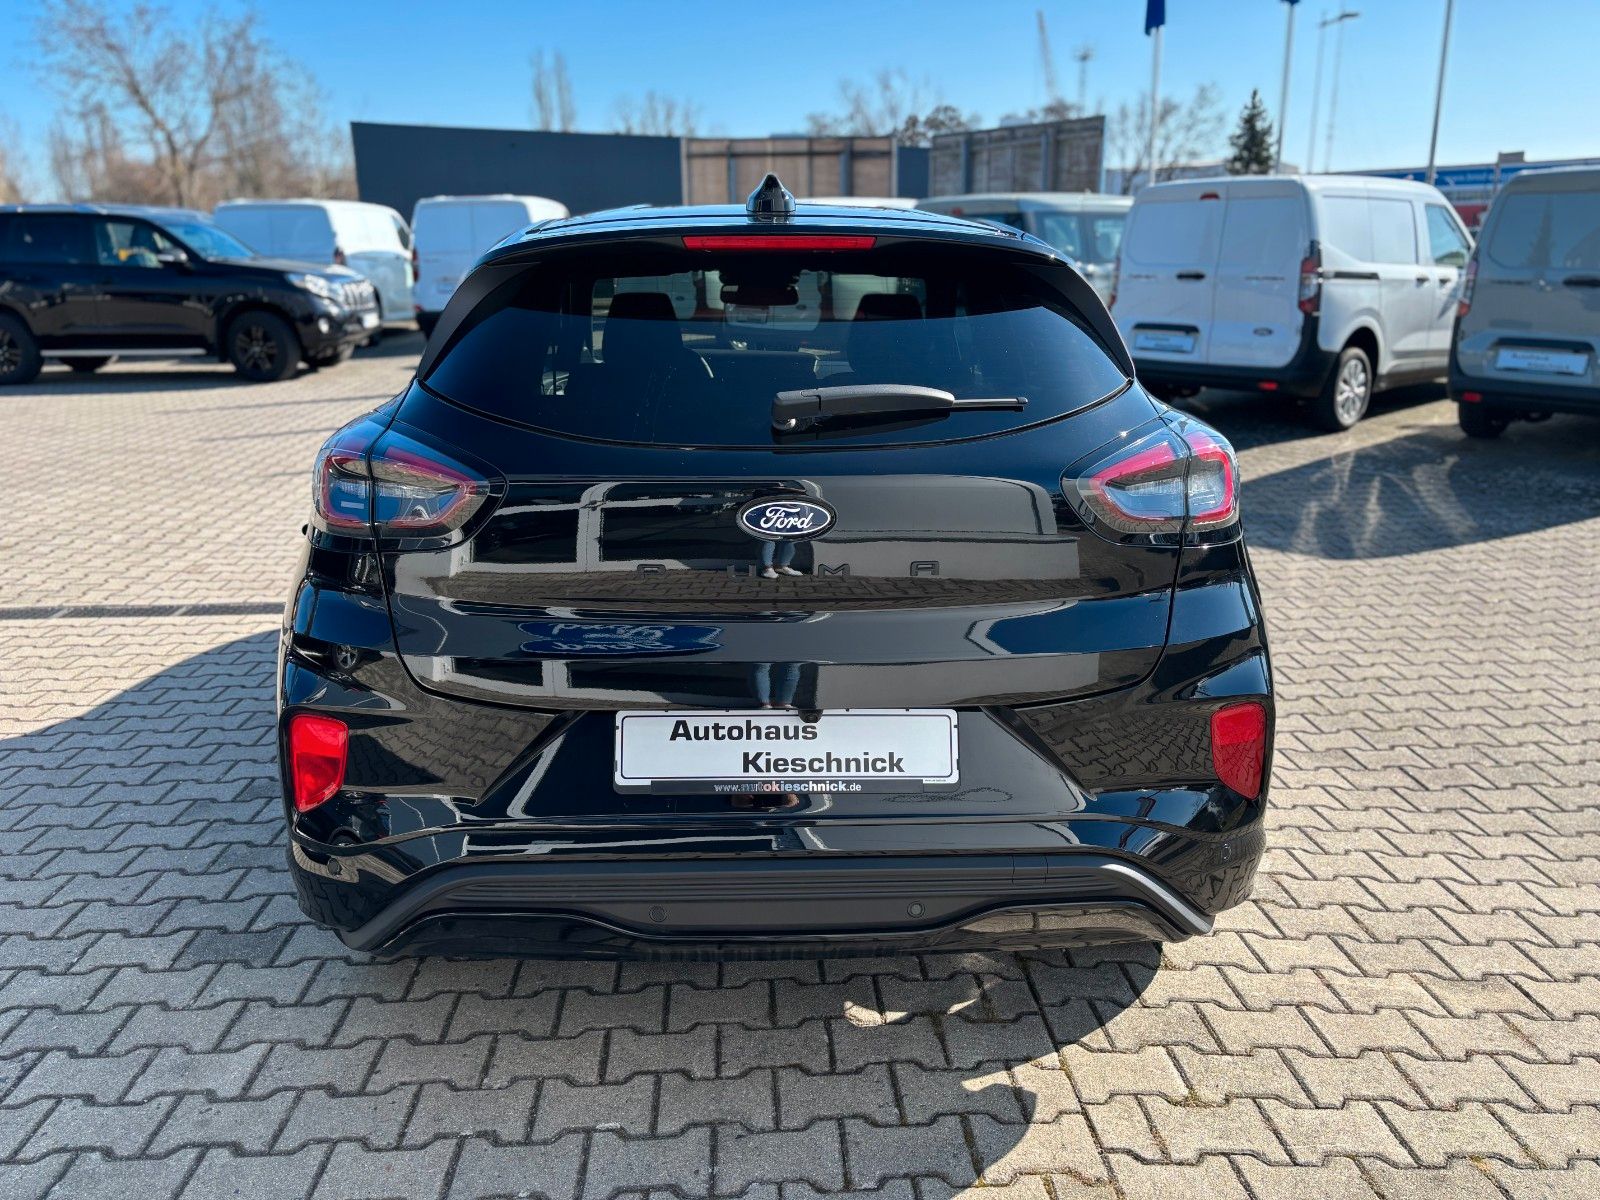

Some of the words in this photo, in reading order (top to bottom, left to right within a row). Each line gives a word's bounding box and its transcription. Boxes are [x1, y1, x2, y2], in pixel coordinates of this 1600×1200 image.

[760, 506, 814, 529] Ford
[636, 560, 940, 578] PUMA
[669, 719, 818, 741] Autohaus
[742, 751, 906, 773] Kieschnick
